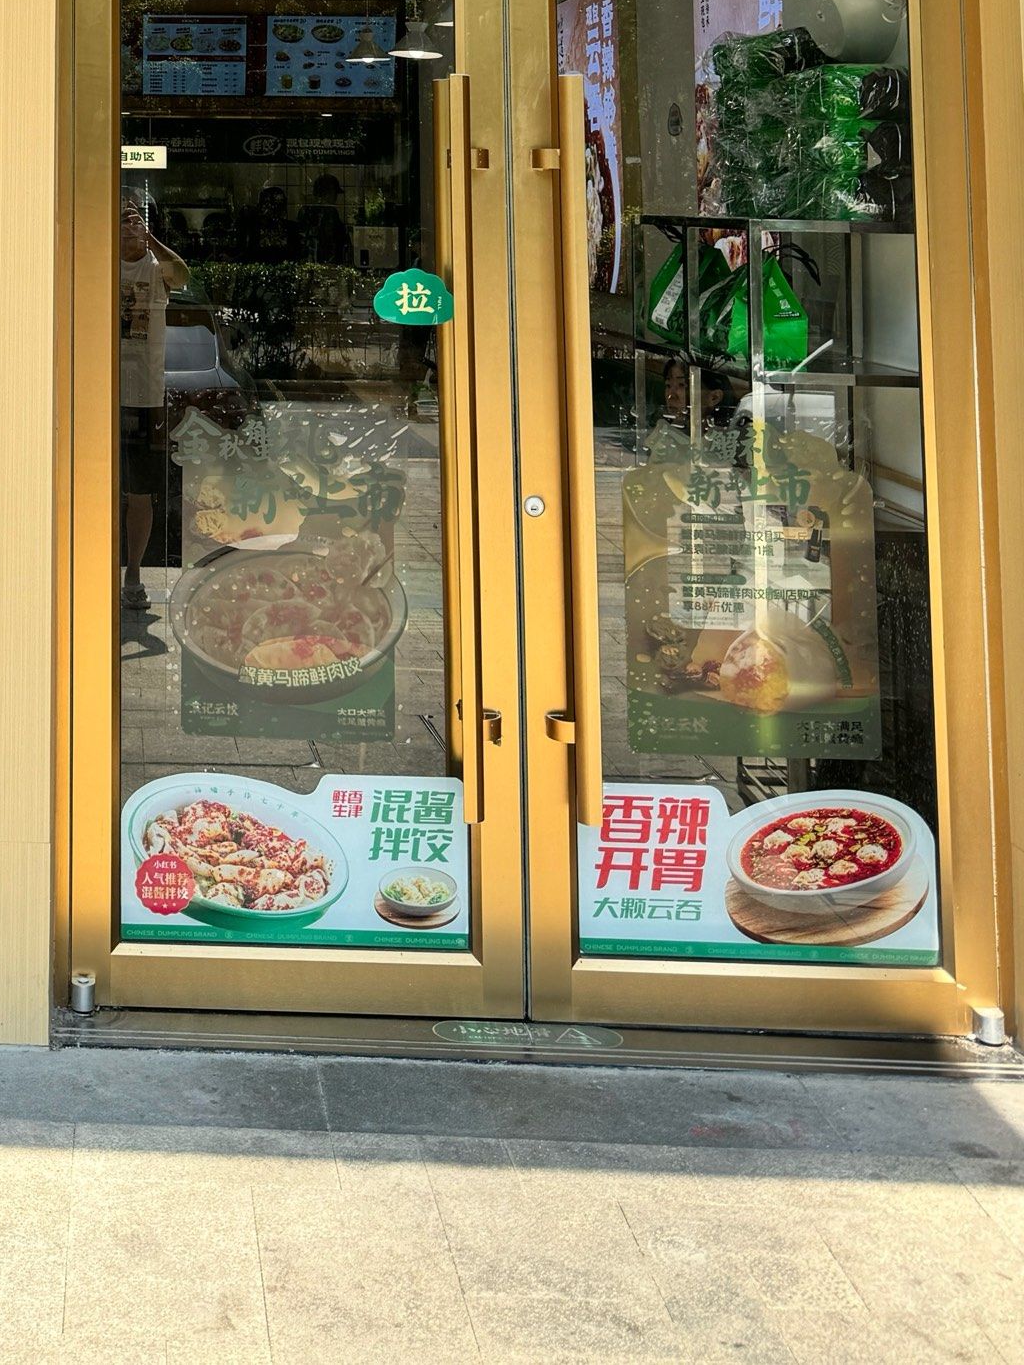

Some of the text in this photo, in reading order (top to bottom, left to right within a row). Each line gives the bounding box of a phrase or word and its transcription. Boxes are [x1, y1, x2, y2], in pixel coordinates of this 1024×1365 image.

[394, 282, 435, 316] 拉
[331, 790, 364, 804] 鲜香
[370, 789, 456, 825] 混酱
[331, 804, 364, 818] 生津
[599, 794, 711, 846] 香辣
[368, 827, 454, 863] 拌饺
[154, 860, 177, 869] 小红书
[594, 846, 706, 893] 开胃
[142, 872, 190, 885] 人气推荐
[141, 886, 189, 900] 混酱拌饺
[592, 897, 703, 923] 大颗云吞
